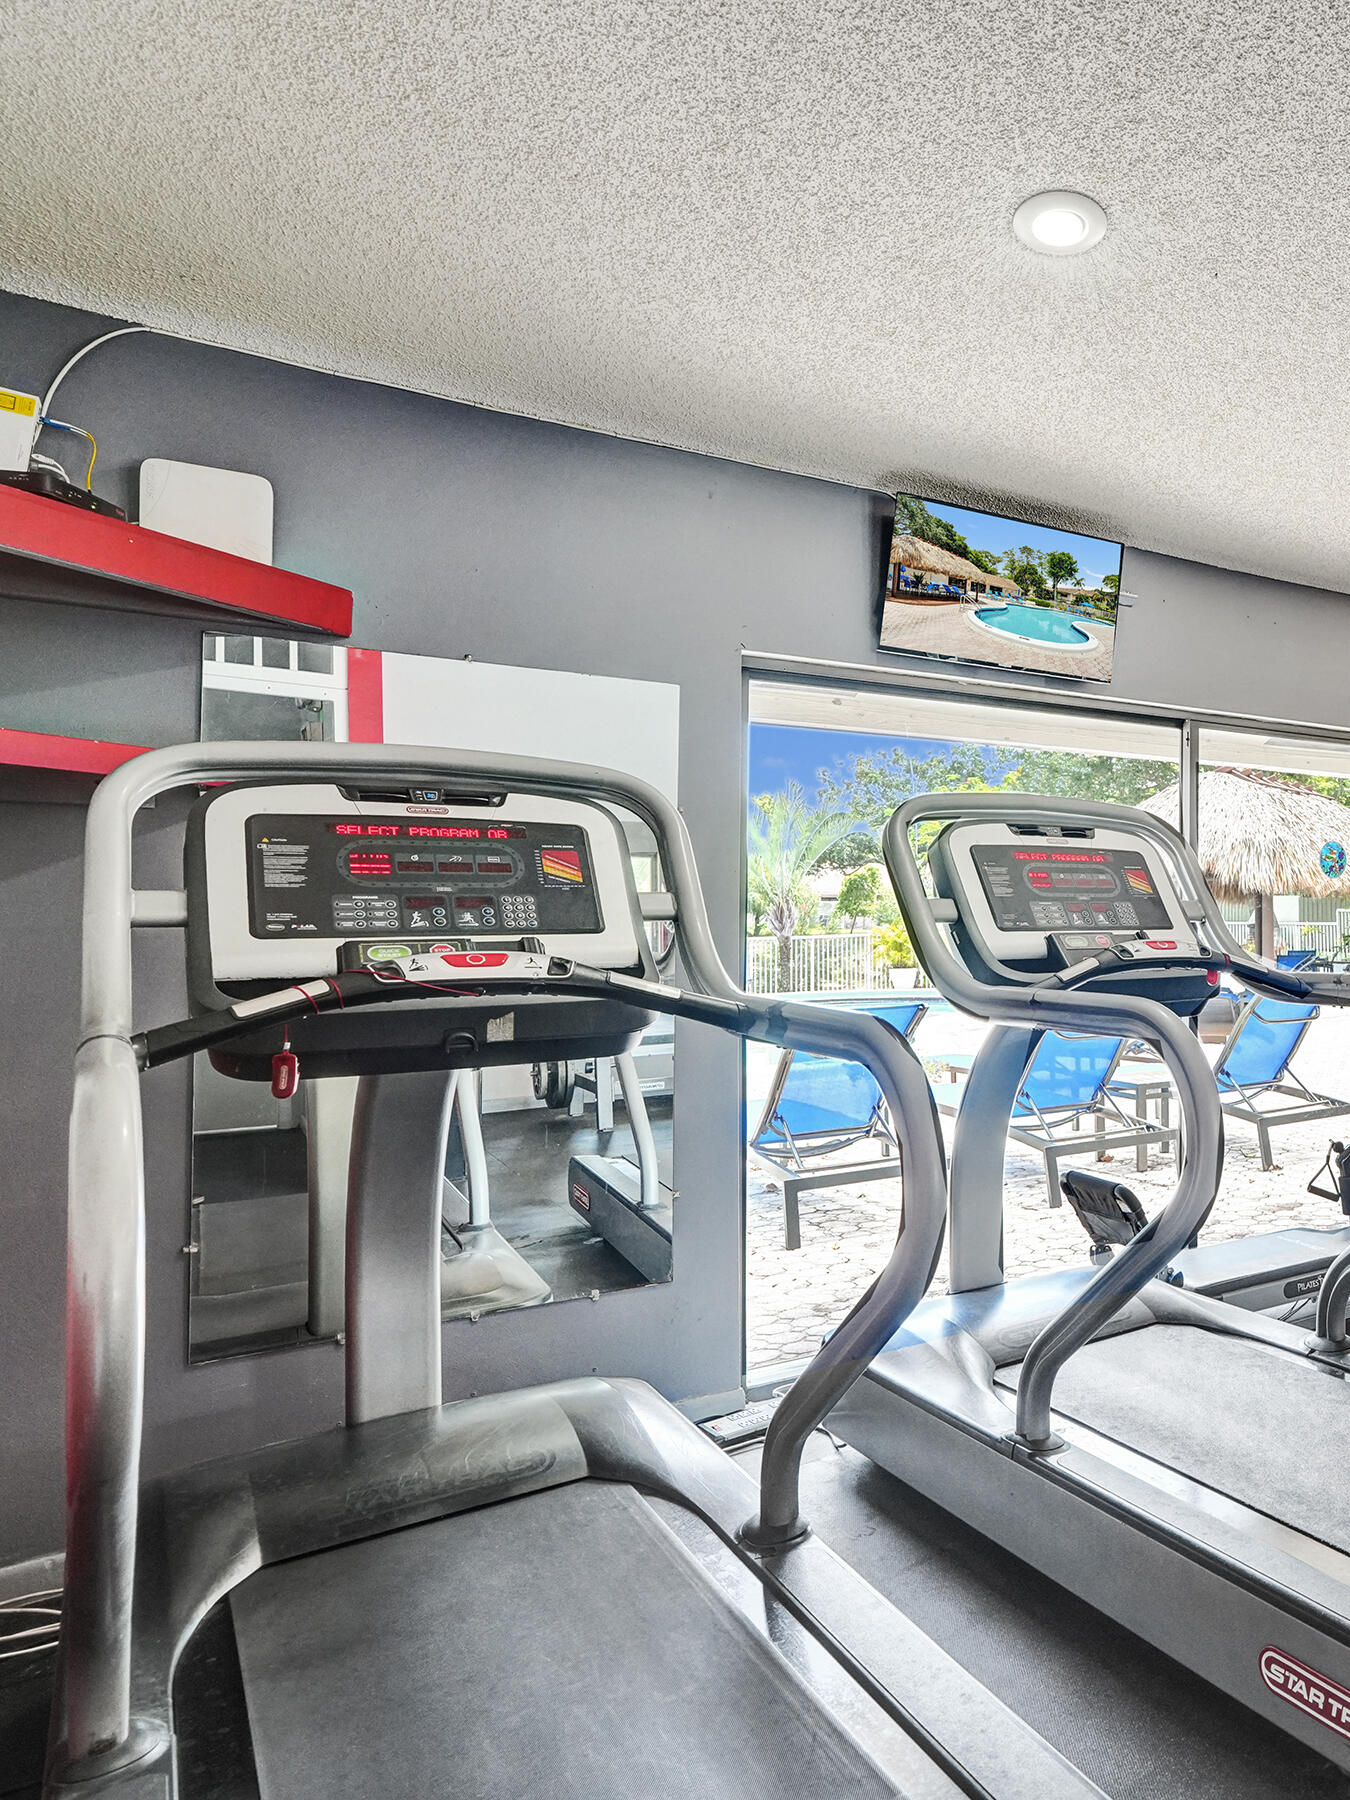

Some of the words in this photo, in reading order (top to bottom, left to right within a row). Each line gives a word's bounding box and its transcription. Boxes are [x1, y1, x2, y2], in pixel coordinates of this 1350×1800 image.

[336, 824, 400, 836] SELECT
[409, 826, 480, 838] PROGRAM
[1297, 1279, 1320, 1292] PILATES
[1265, 1663, 1325, 1710] STAR
